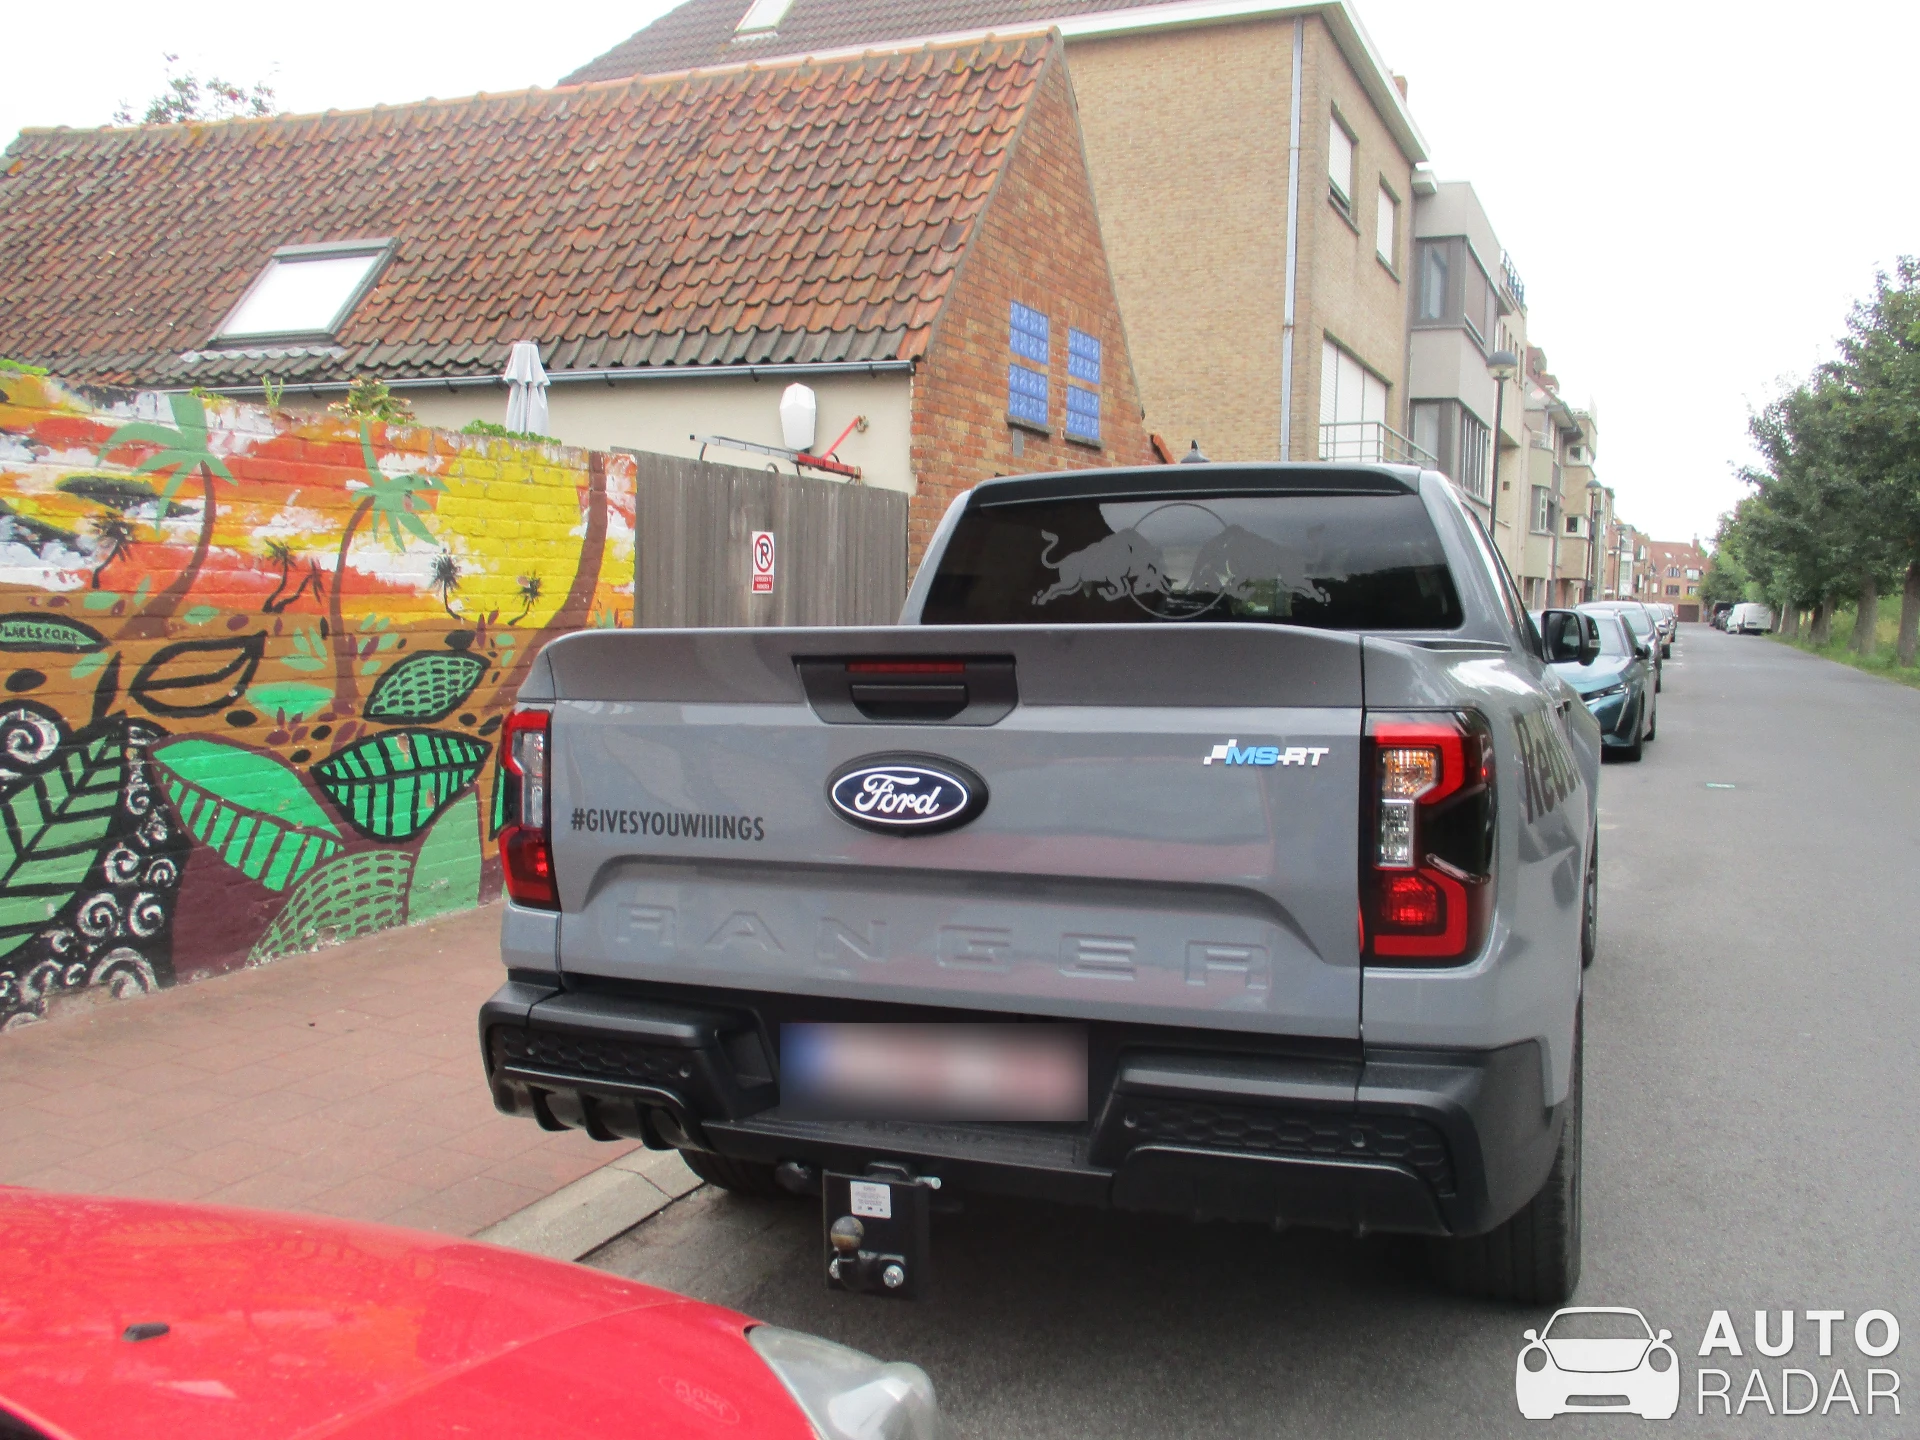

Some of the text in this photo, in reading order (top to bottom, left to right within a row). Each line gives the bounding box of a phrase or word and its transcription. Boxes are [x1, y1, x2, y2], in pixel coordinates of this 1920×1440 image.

[854, 773, 940, 815] Ford
[571, 807, 765, 841] #GIVESYOUWIIINGS
[615, 901, 1273, 991] RANGER
